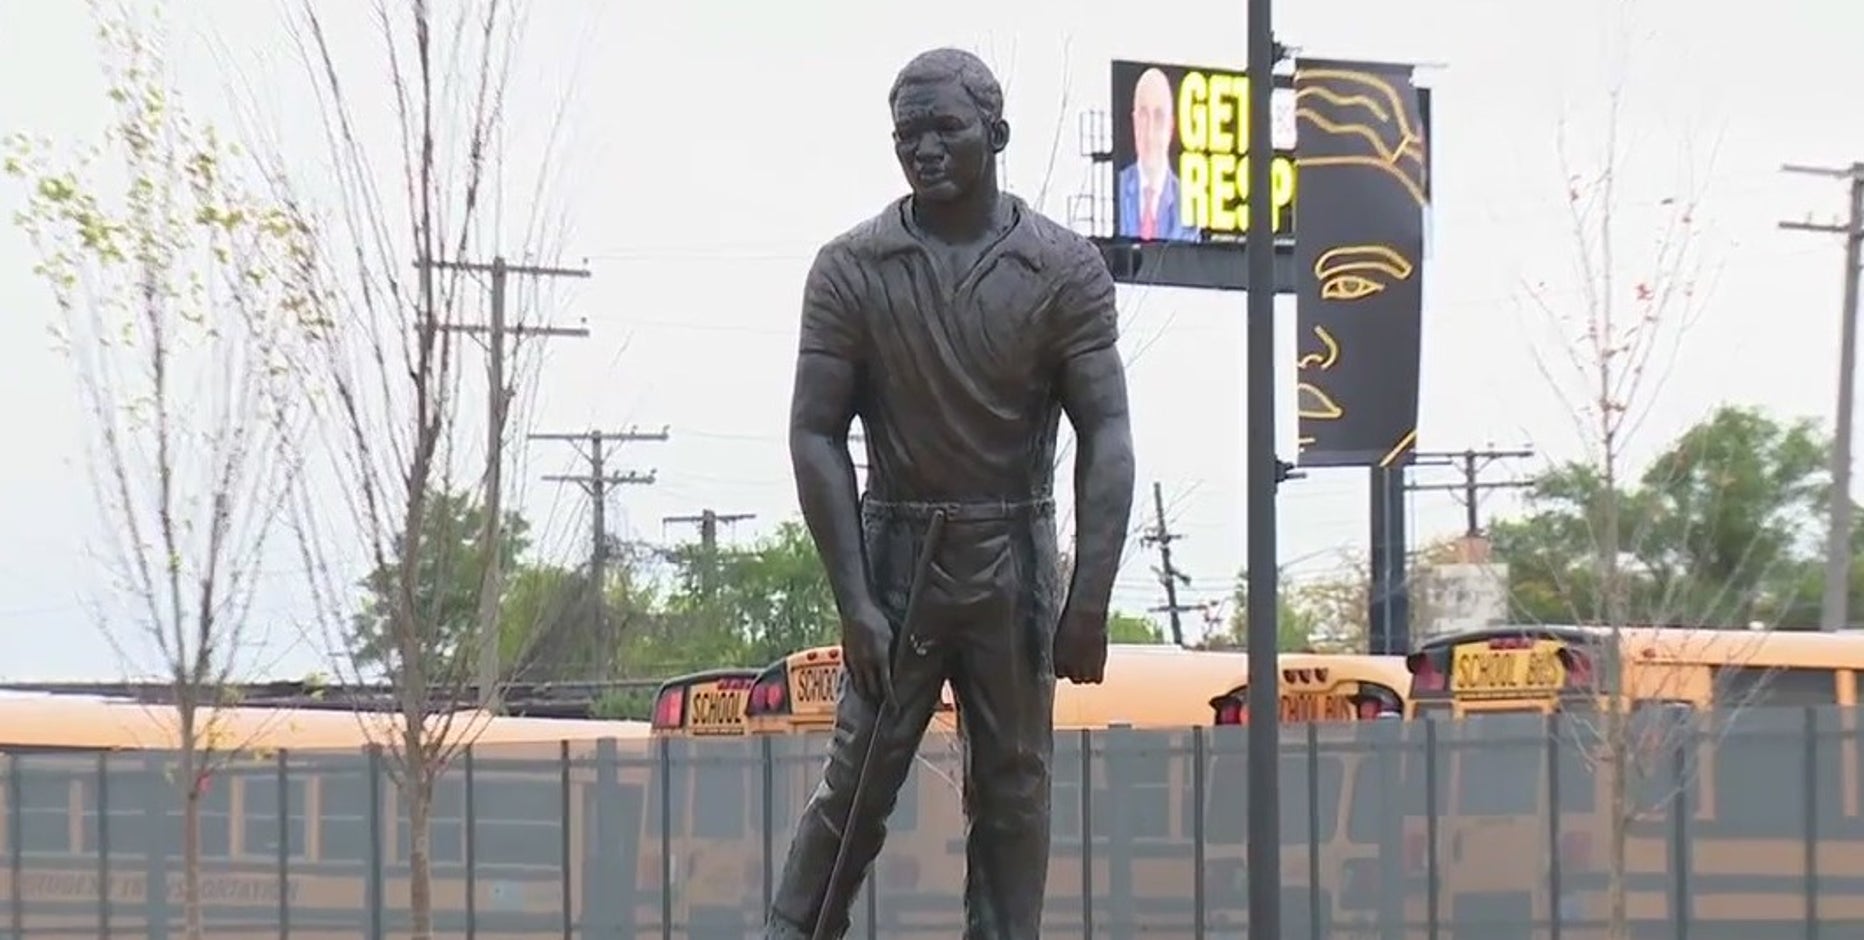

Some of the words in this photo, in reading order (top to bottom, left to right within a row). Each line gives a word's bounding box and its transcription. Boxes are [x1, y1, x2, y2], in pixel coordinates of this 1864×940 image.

[1457, 652, 1517, 688] SCHOOL
[1525, 650, 1558, 686] BUS
[692, 692, 741, 724] SCHOOL
[1279, 694, 1320, 722] CHOOL
[1325, 694, 1351, 722] BUS
